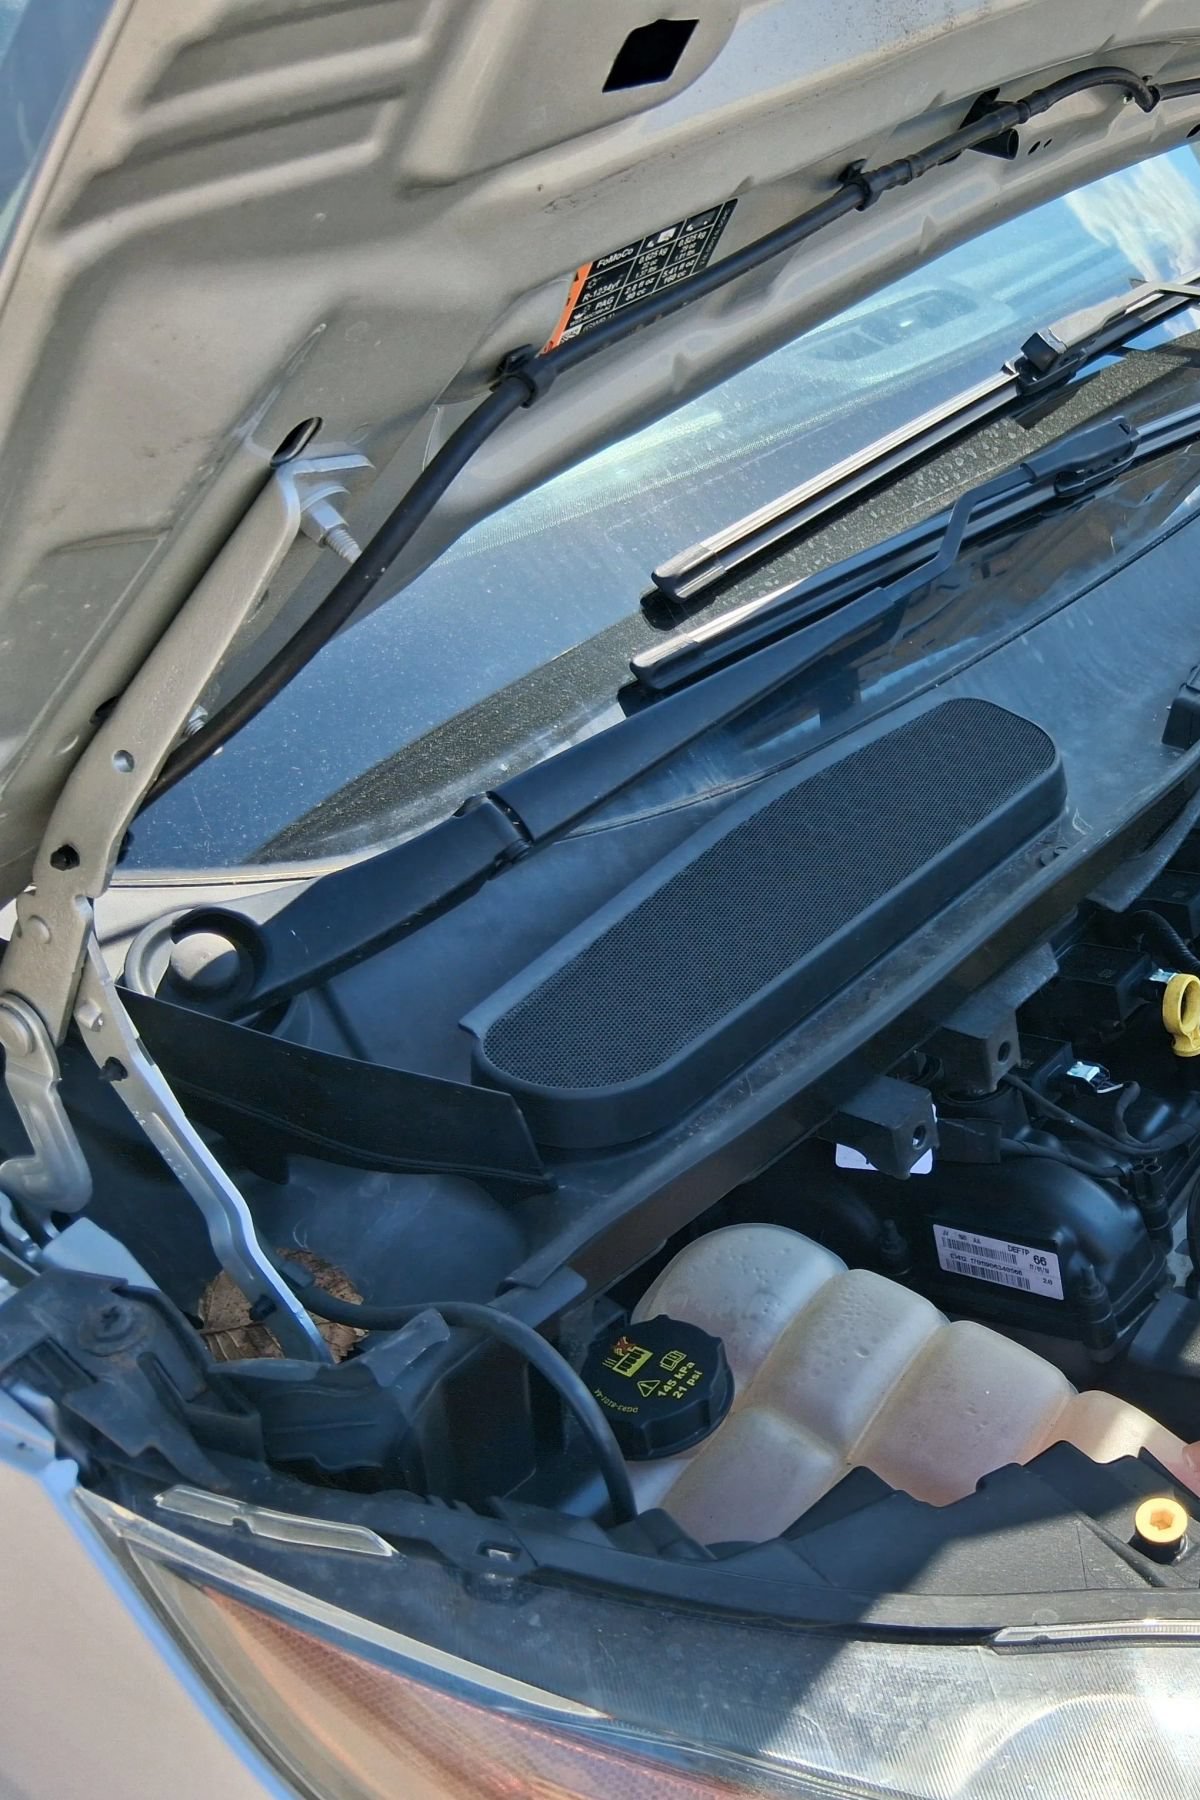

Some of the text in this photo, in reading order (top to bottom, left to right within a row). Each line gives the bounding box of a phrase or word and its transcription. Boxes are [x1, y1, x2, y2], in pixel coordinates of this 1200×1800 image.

[596, 248, 634, 269] FoMoCo
[582, 279, 622, 302] R-1234yf
[595, 296, 614, 310] PAG
[1033, 1254, 1047, 1266] 66
[658, 1361, 696, 1397] 145 kPa
[672, 1370, 704, 1400] 21 psi
